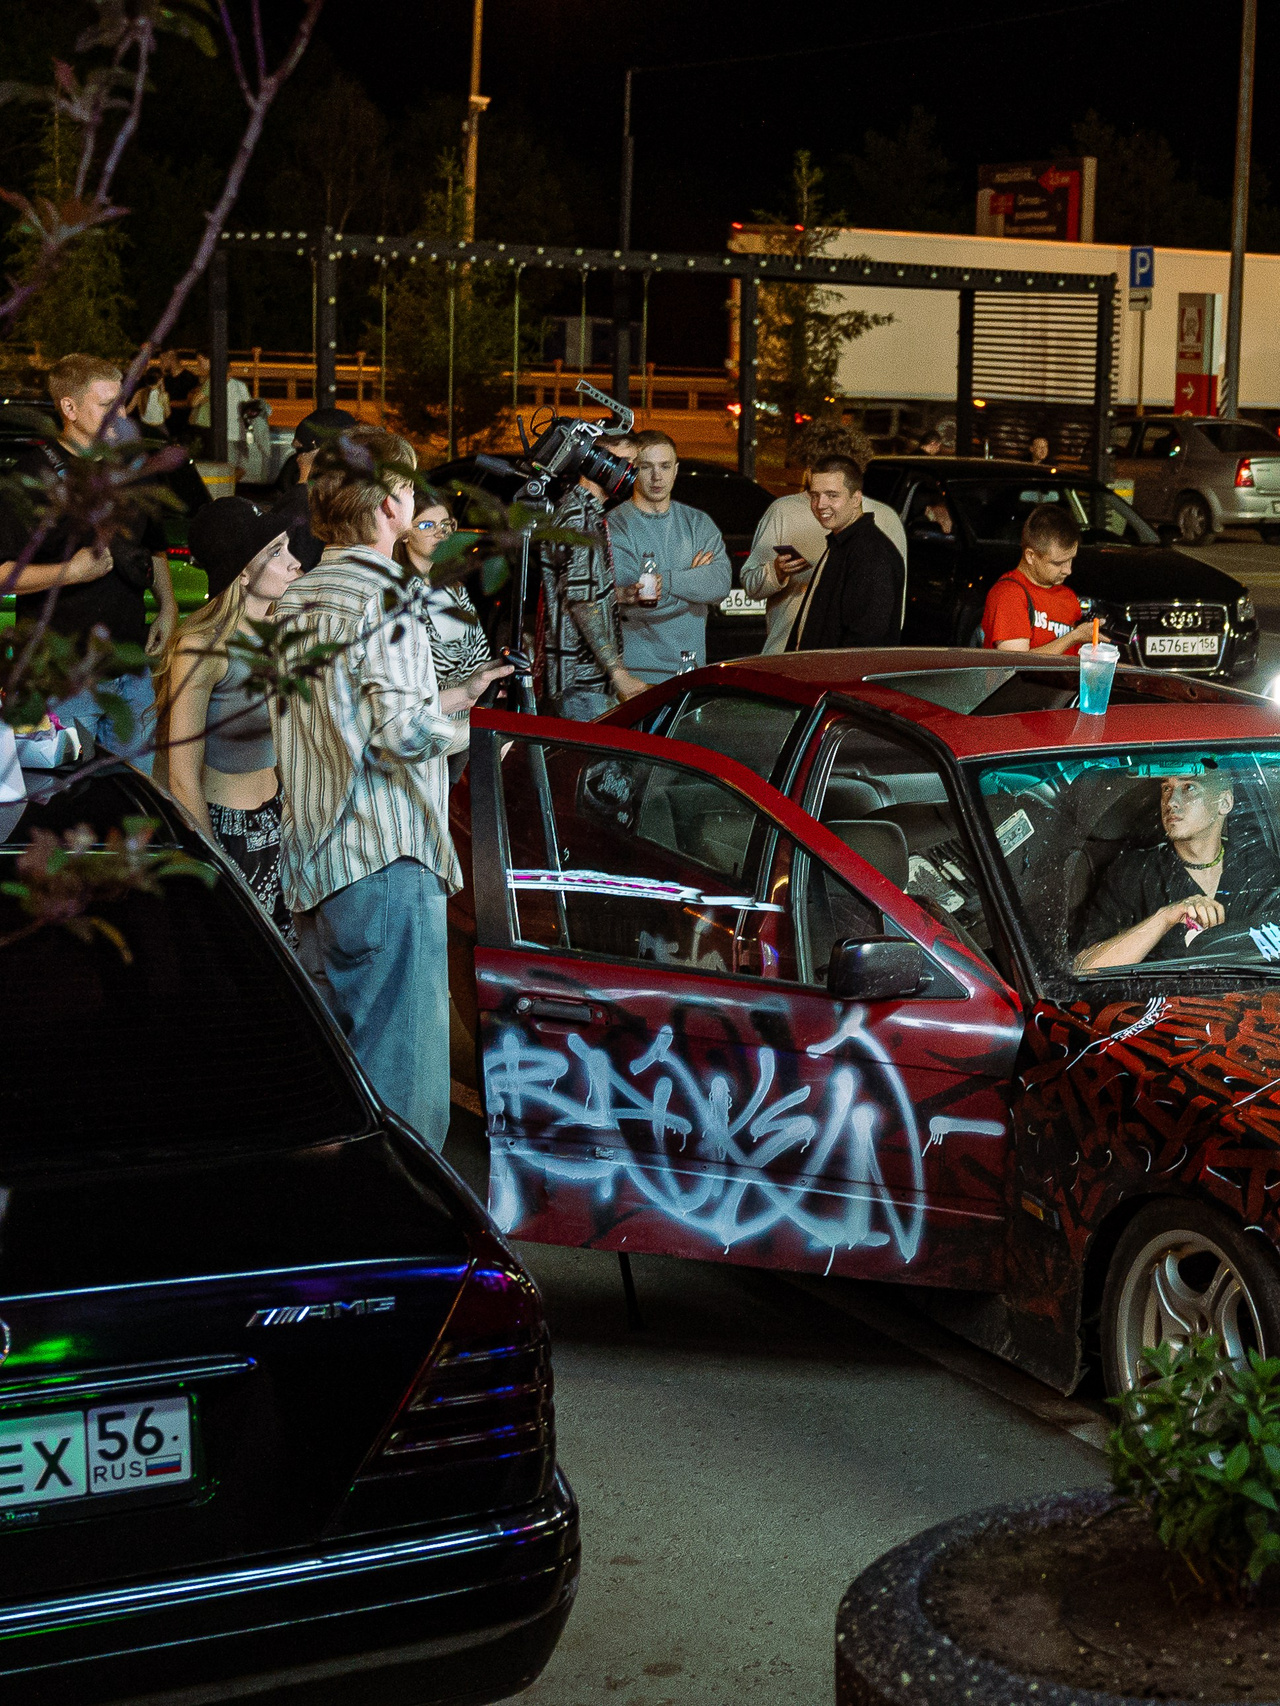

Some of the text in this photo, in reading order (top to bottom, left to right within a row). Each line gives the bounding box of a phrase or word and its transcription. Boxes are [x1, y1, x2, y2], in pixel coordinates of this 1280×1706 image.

[1135, 252, 1150, 285] P
[1199, 638, 1215, 650] 156
[97, 1406, 165, 1462] 56
[93, 1460, 143, 1484] RUS
